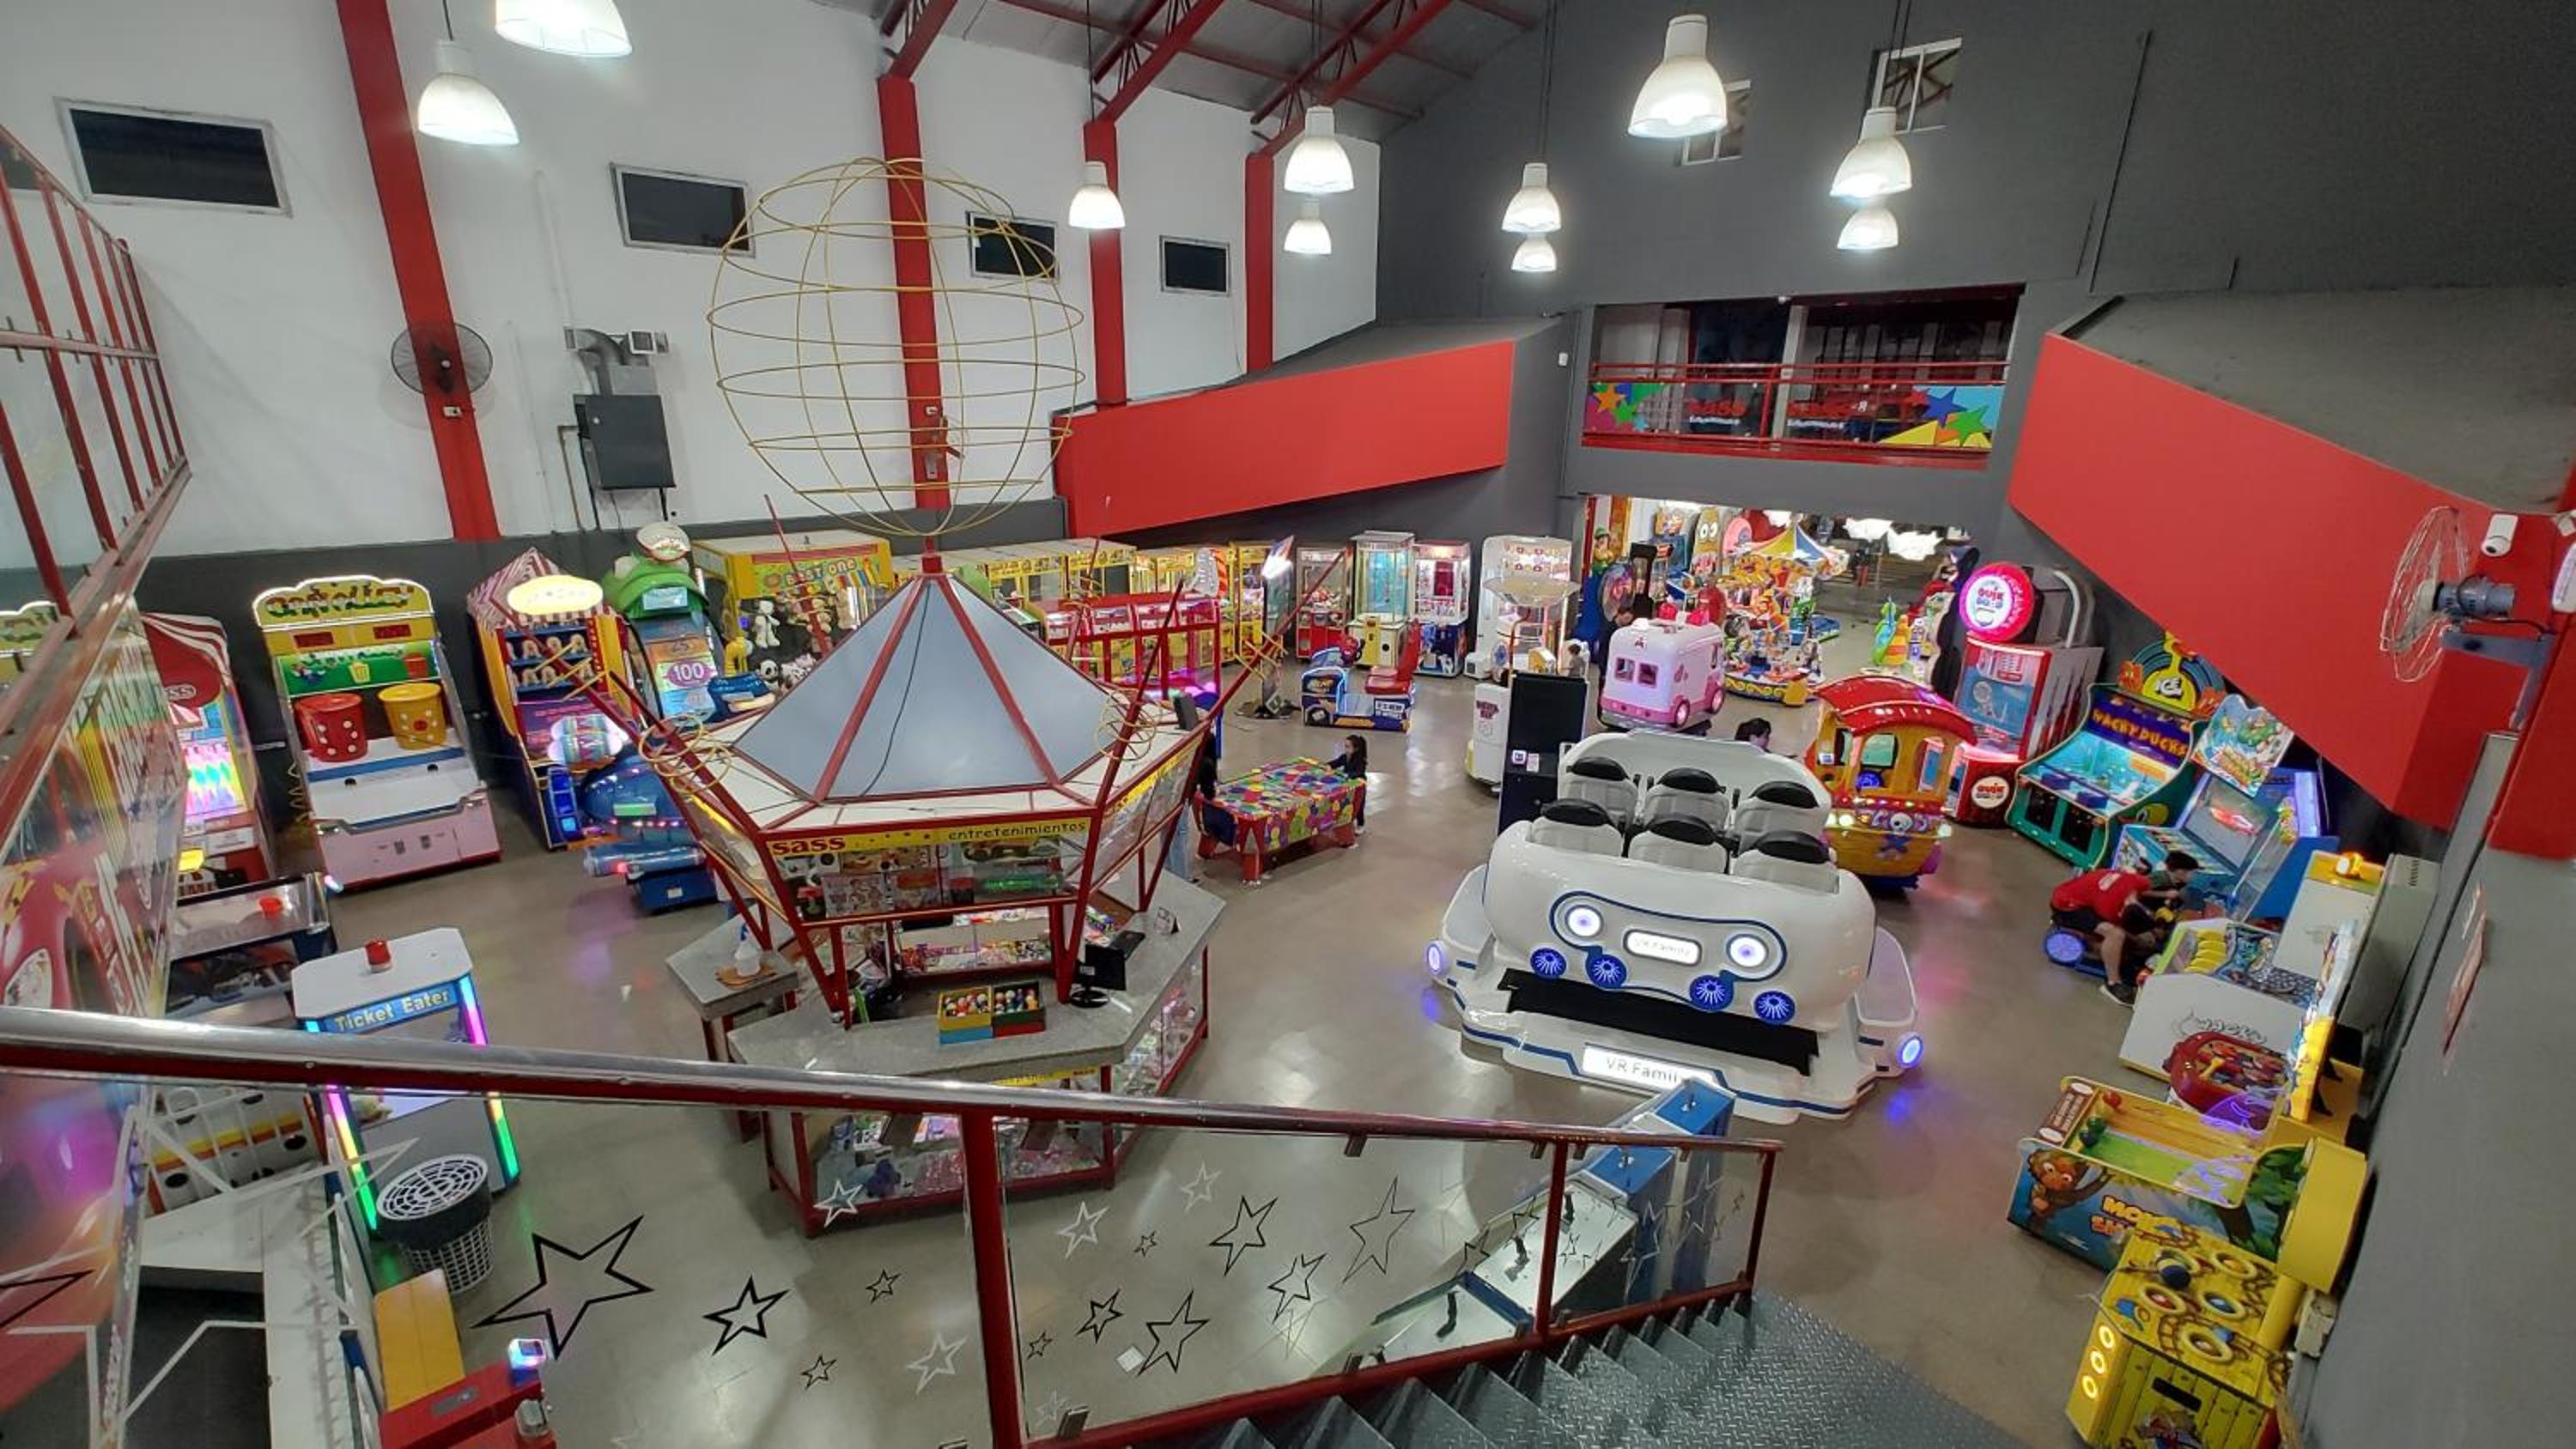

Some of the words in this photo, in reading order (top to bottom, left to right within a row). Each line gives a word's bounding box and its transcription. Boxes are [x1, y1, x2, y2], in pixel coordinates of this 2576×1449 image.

[673, 662, 705, 682] 100
[2093, 709, 2142, 737] WACKY
[773, 837, 846, 855] sass
[948, 822, 1086, 840] entretenimientos
[335, 1003, 394, 1031] Ticket
[401, 990, 449, 1012] Eater
[1607, 1056, 1628, 1072] VR
